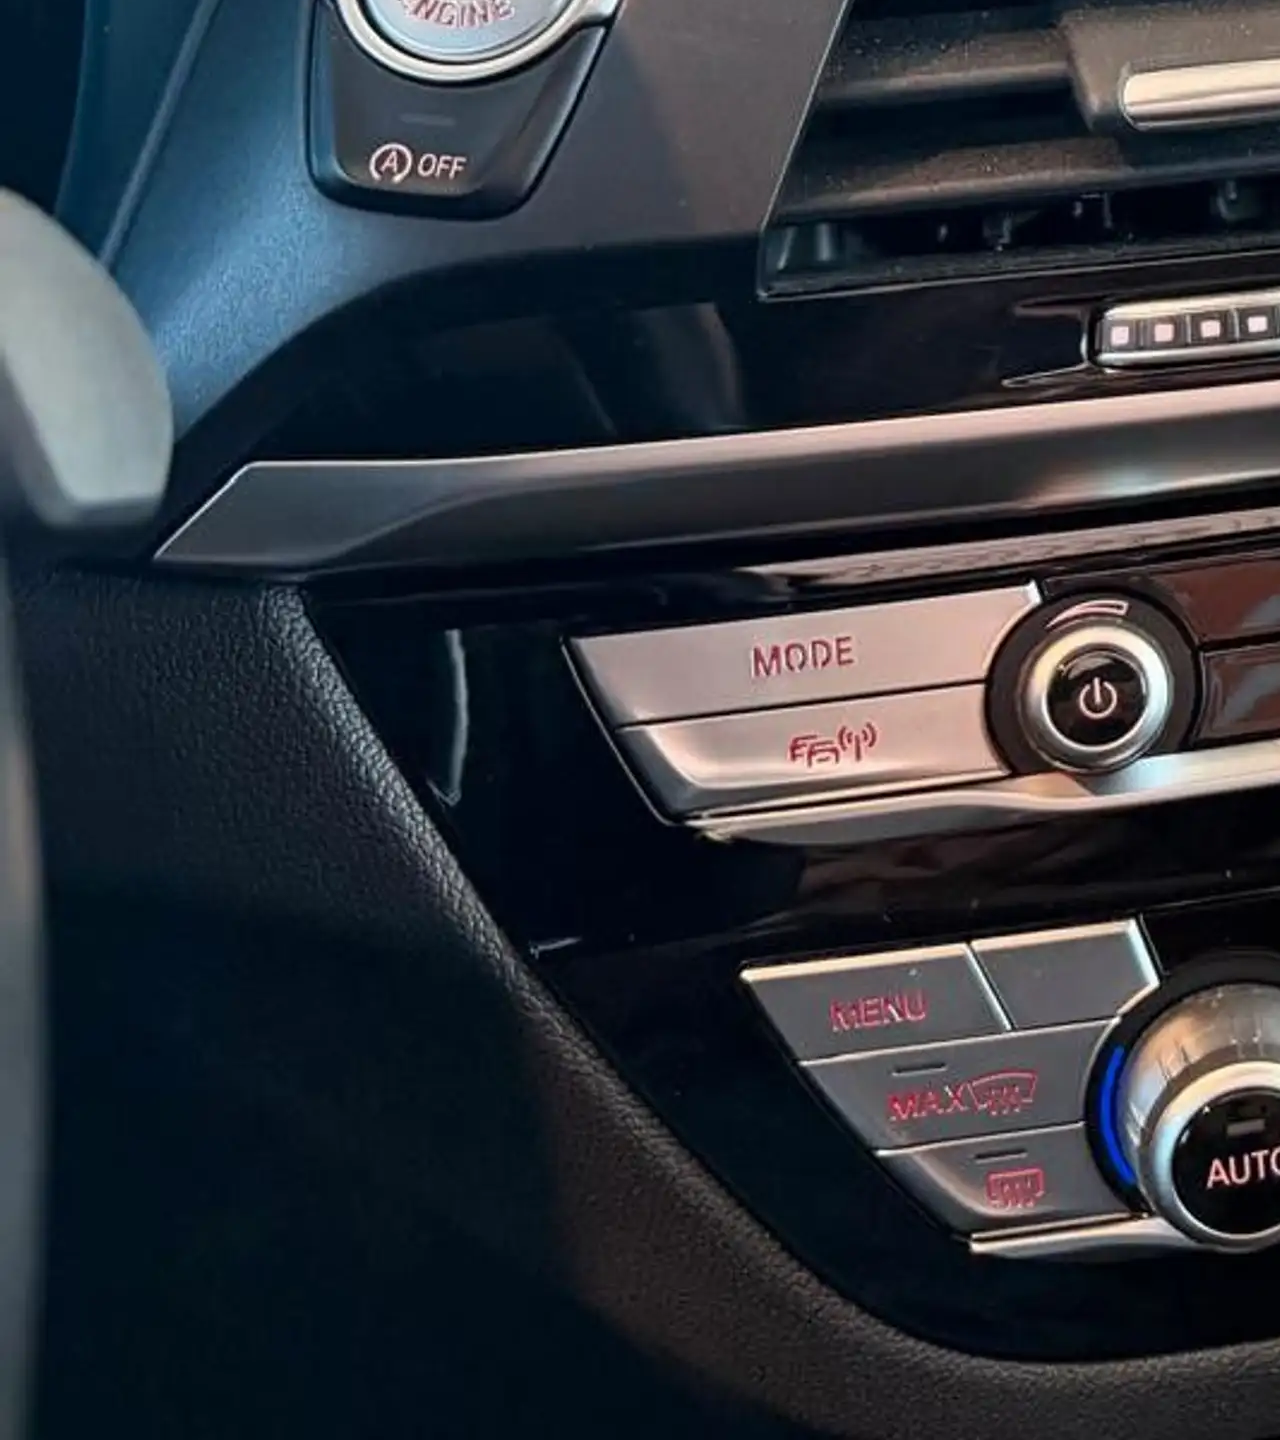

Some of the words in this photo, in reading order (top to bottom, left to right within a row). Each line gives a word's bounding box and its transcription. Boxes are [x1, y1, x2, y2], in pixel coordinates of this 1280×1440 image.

[417, 154, 467, 180] OFF
[750, 637, 855, 678] MODE
[830, 989, 928, 1033] MENU
[887, 1085, 964, 1122] MAX
